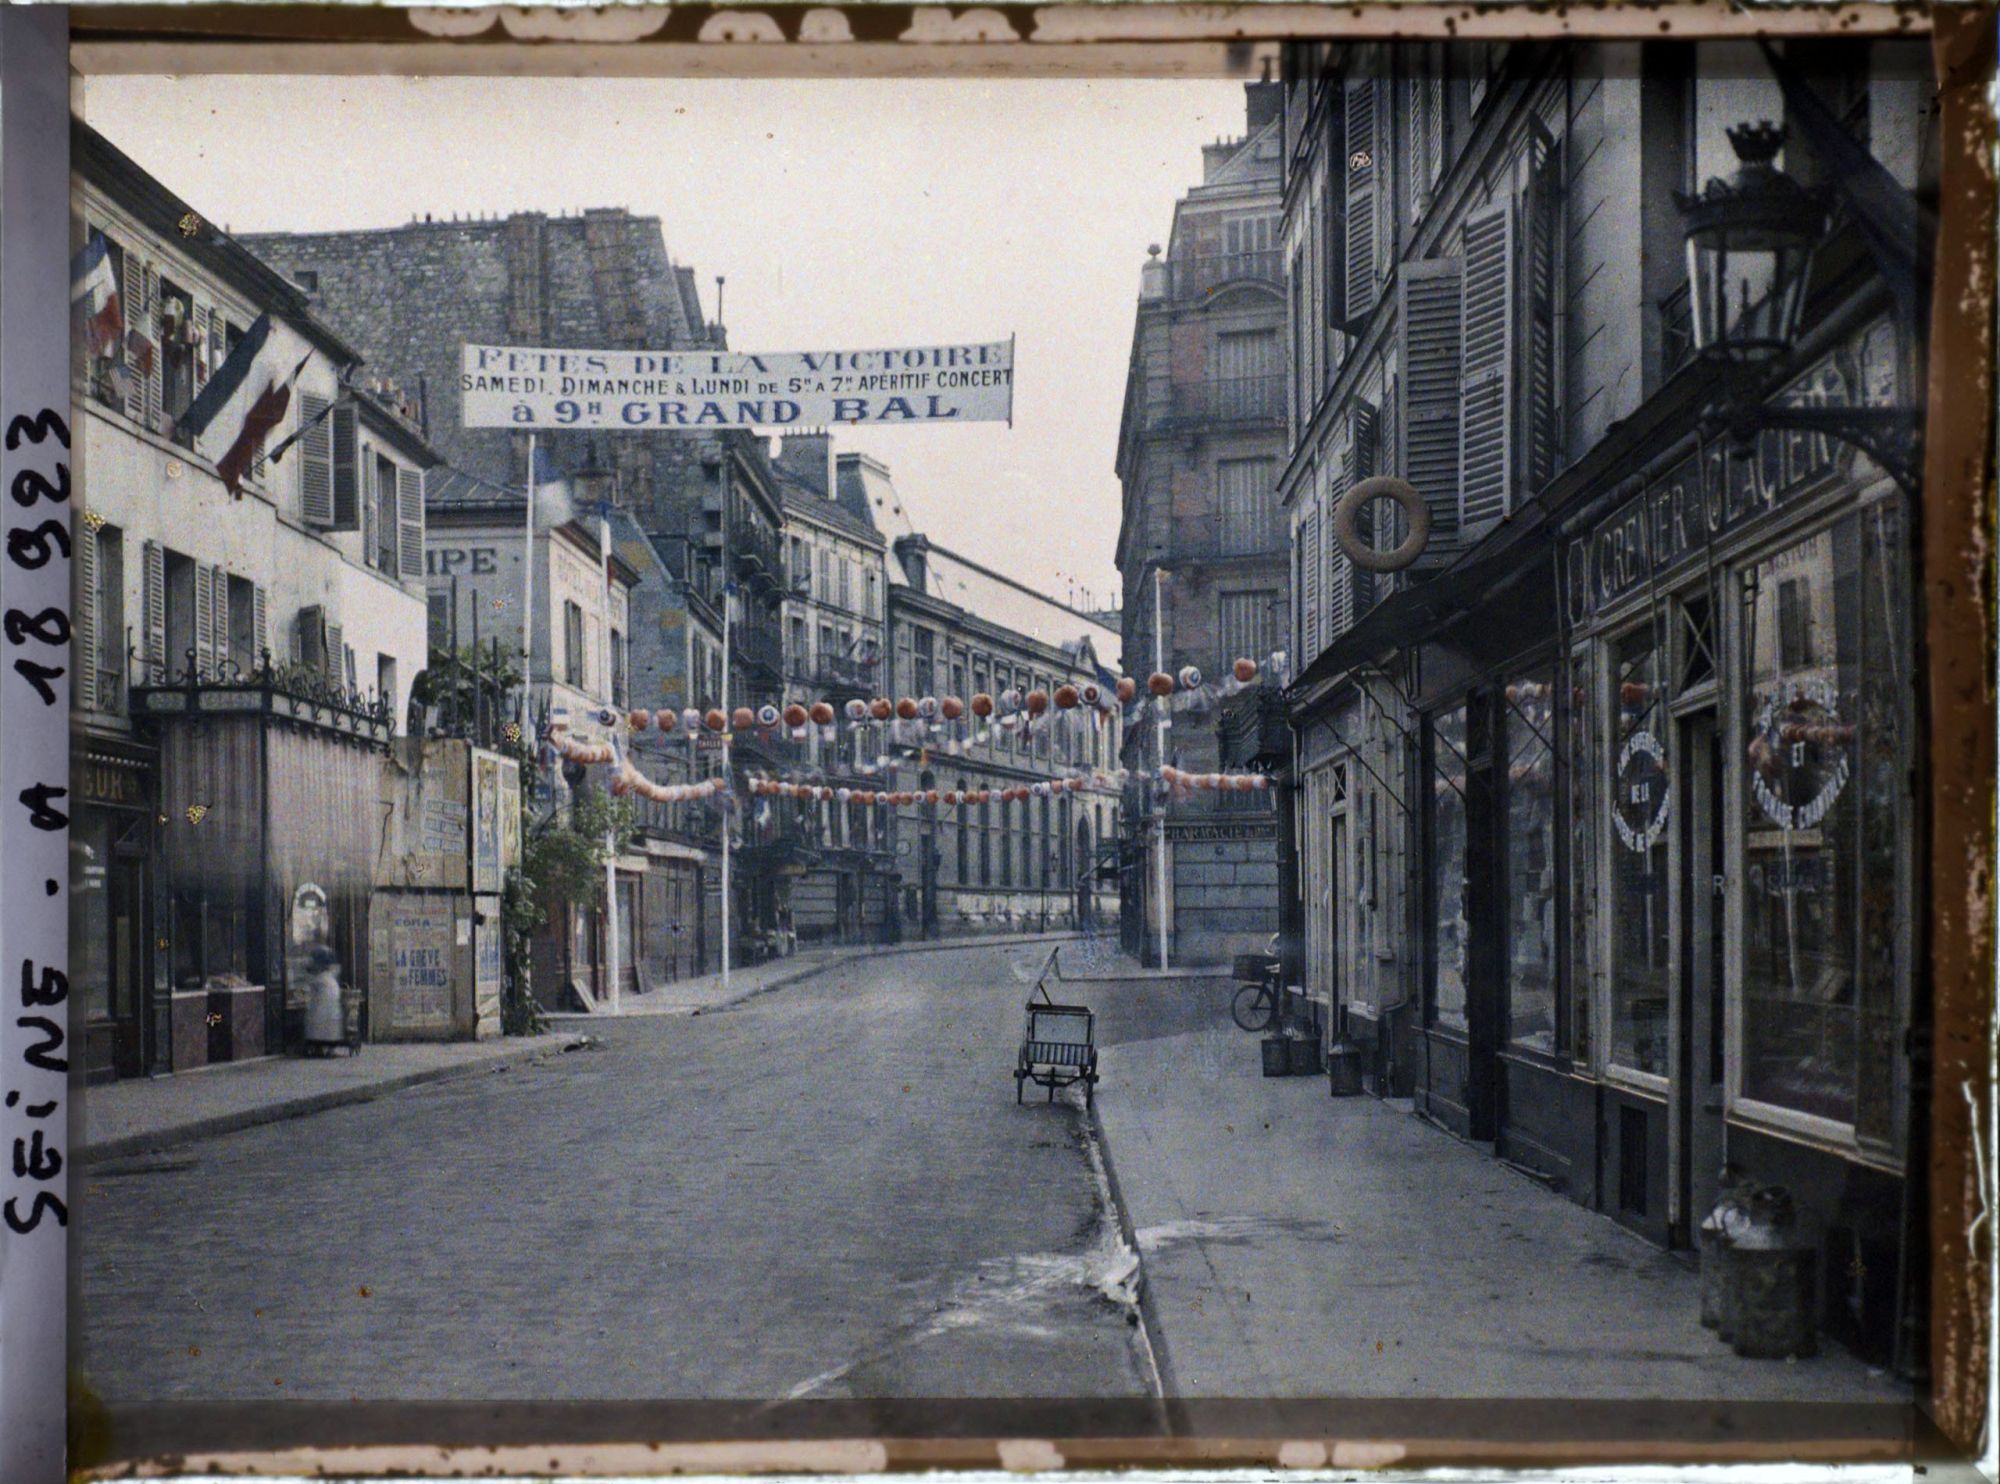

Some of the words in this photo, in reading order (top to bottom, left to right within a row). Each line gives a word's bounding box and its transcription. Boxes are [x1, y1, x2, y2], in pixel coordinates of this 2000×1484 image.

[634, 355, 684, 375] DE
[711, 355, 769, 374] LA
[801, 345, 1002, 371] VICTOIRE
[561, 376, 668, 396] DIMANCHE
[675, 383, 687, 395] &
[691, 377, 749, 395] LUNDI
[758, 383, 778, 394] DE
[937, 368, 1012, 388] CONCERT
[621, 400, 801, 425] GRAND
[832, 395, 959, 421] BAL
